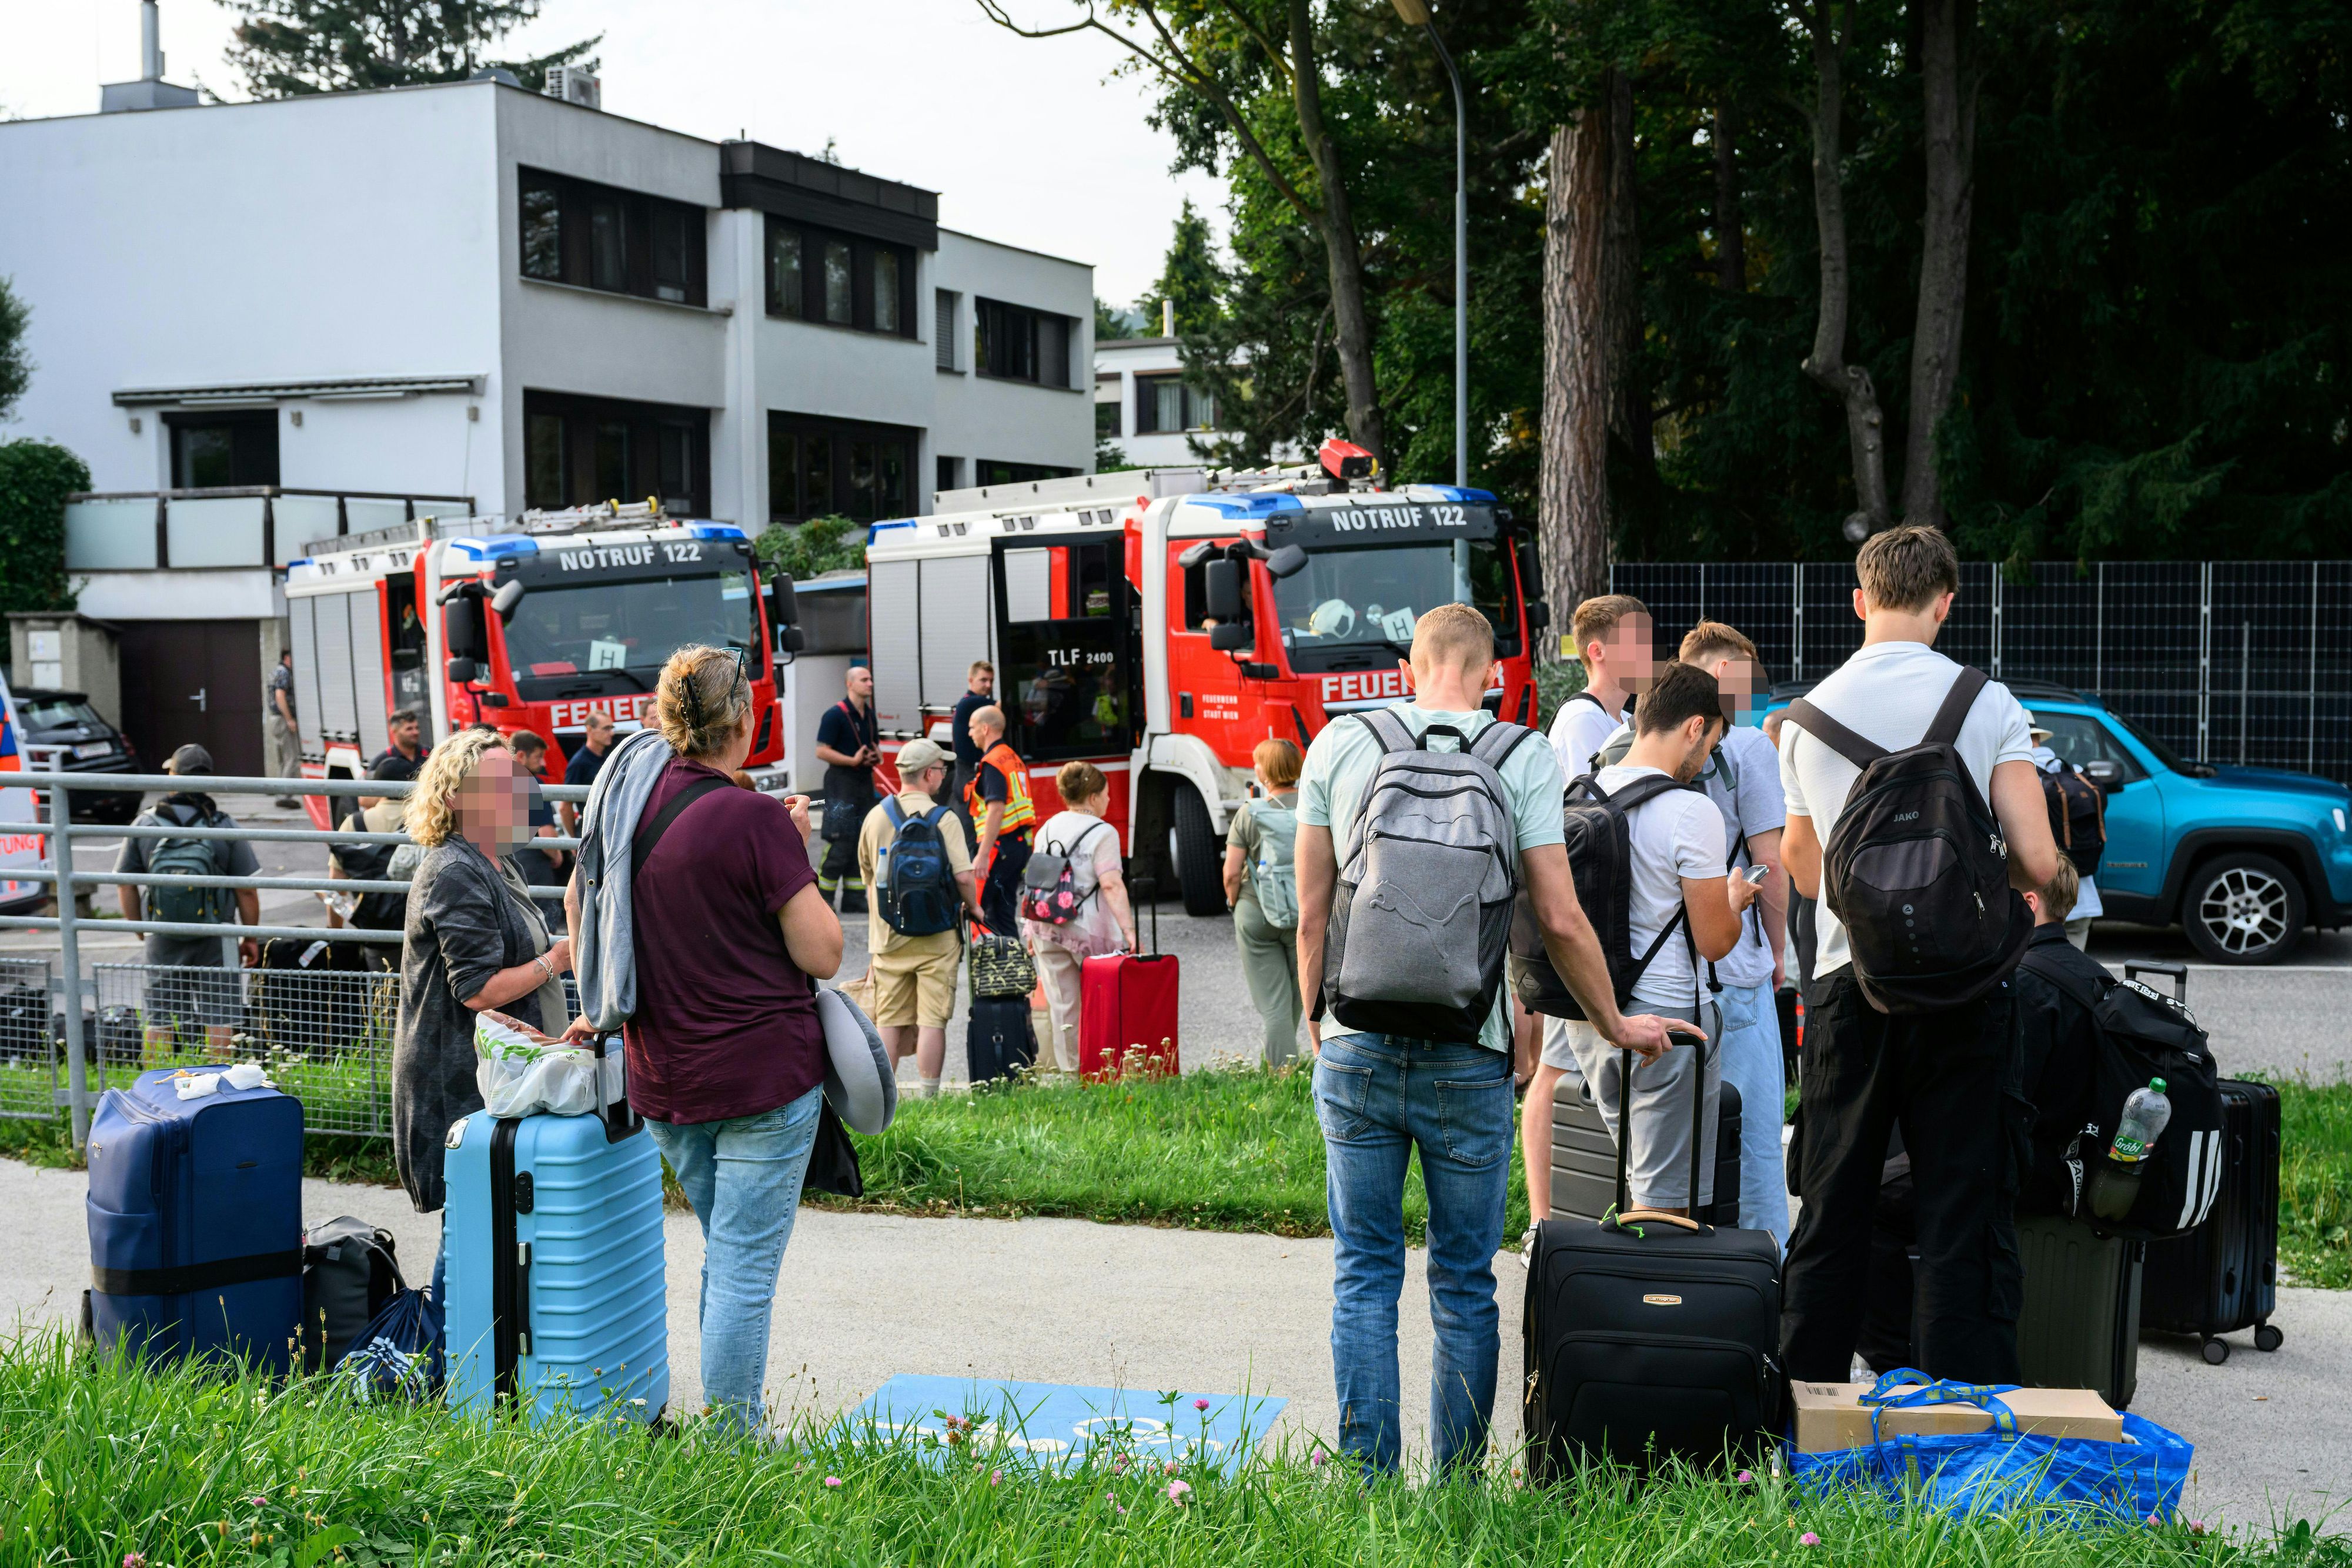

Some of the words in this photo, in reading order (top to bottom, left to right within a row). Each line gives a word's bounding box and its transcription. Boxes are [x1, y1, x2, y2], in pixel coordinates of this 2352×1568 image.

[1331, 507, 1422, 531] NOTRUF
[1429, 506, 1467, 526] 122
[560, 545, 655, 571] NOTRUF
[663, 543, 702, 563] 122
[1392, 617, 1409, 639] H
[600, 649, 615, 668] H
[1047, 648, 1080, 666] TLF
[1086, 651, 1114, 664] 2400
[1894, 811, 1919, 822] JAKO
[2115, 1138, 2143, 1152] Gröbi
